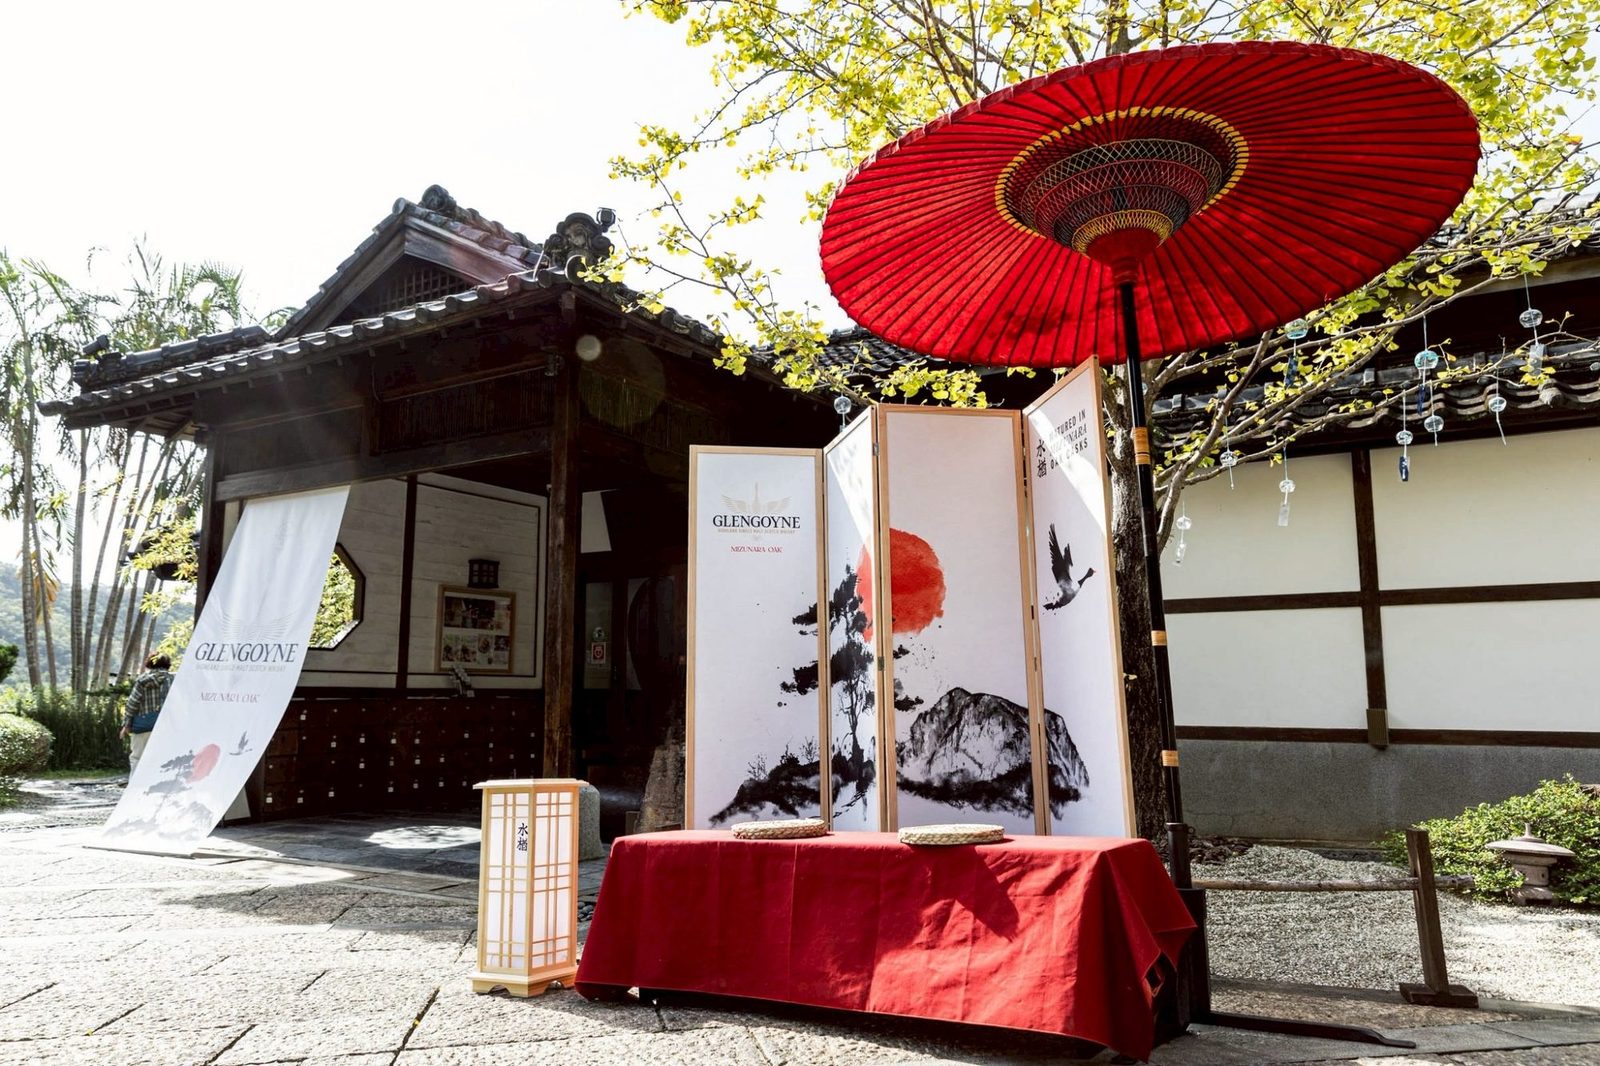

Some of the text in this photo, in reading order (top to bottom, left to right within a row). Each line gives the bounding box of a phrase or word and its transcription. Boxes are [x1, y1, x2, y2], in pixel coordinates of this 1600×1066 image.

[1079, 409, 1086, 422] IN
[712, 514, 801, 529] GLENGOYNE
[730, 545, 766, 553] MIZUNARA
[194, 642, 299, 663] GLENGOYNE
